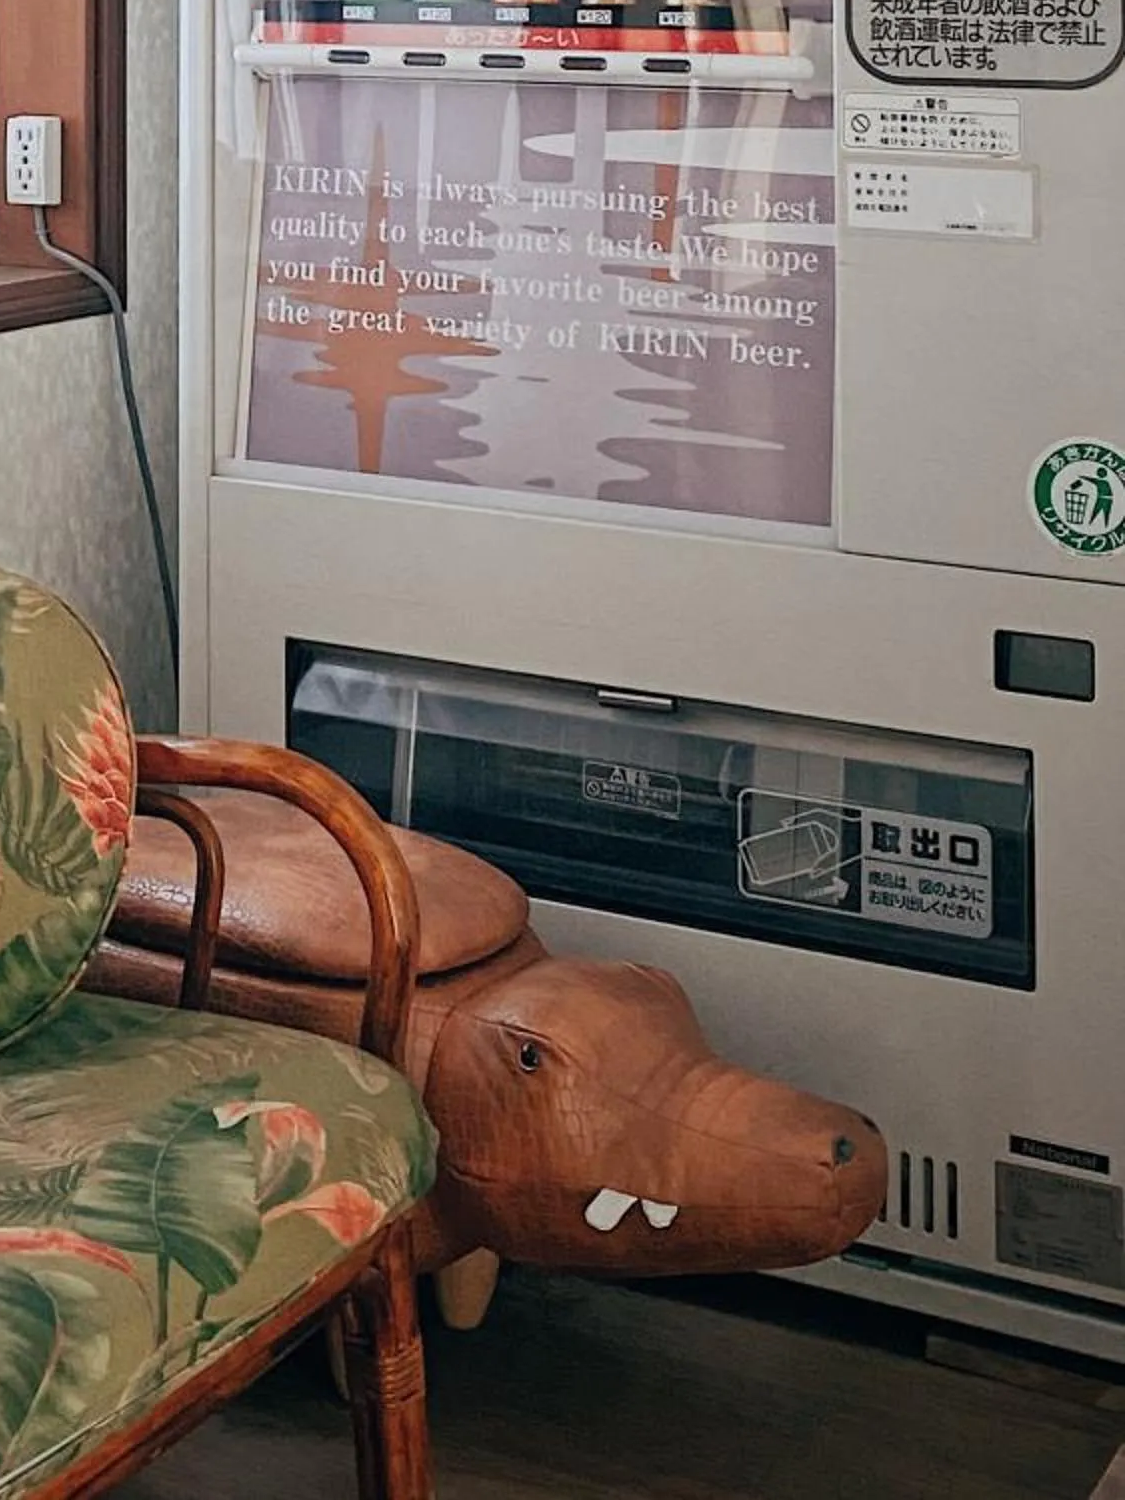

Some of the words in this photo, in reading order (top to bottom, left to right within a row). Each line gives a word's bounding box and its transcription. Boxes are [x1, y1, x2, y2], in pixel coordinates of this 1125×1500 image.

[870, 17, 1106, 47] 飲酒運転は法律で禁止
[870, 44, 997, 71] されています。
[275, 165, 368, 197] KIRIN
[382, 171, 405, 198] is
[418, 173, 517, 209] always
[532, 184, 670, 220] pursuing
[686, 188, 738, 218] the
[753, 191, 819, 224] best
[271, 212, 364, 245] quality
[378, 216, 406, 242] to
[420, 221, 484, 249] each
[679, 235, 728, 266] We
[741, 239, 818, 277] hope
[267, 258, 315, 283] you
[328, 257, 386, 287] find
[397, 268, 464, 293] your
[480, 268, 602, 303] favorite
[618, 275, 687, 309] beer
[702, 291, 818, 327] among
[266, 296, 310, 325] the
[328, 307, 406, 334] great
[425, 312, 532, 348] variety
[548, 320, 580, 349] of
[600, 323, 709, 360] KIRIN
[730, 334, 811, 369] beer.
[871, 821, 980, 867] 取出口
